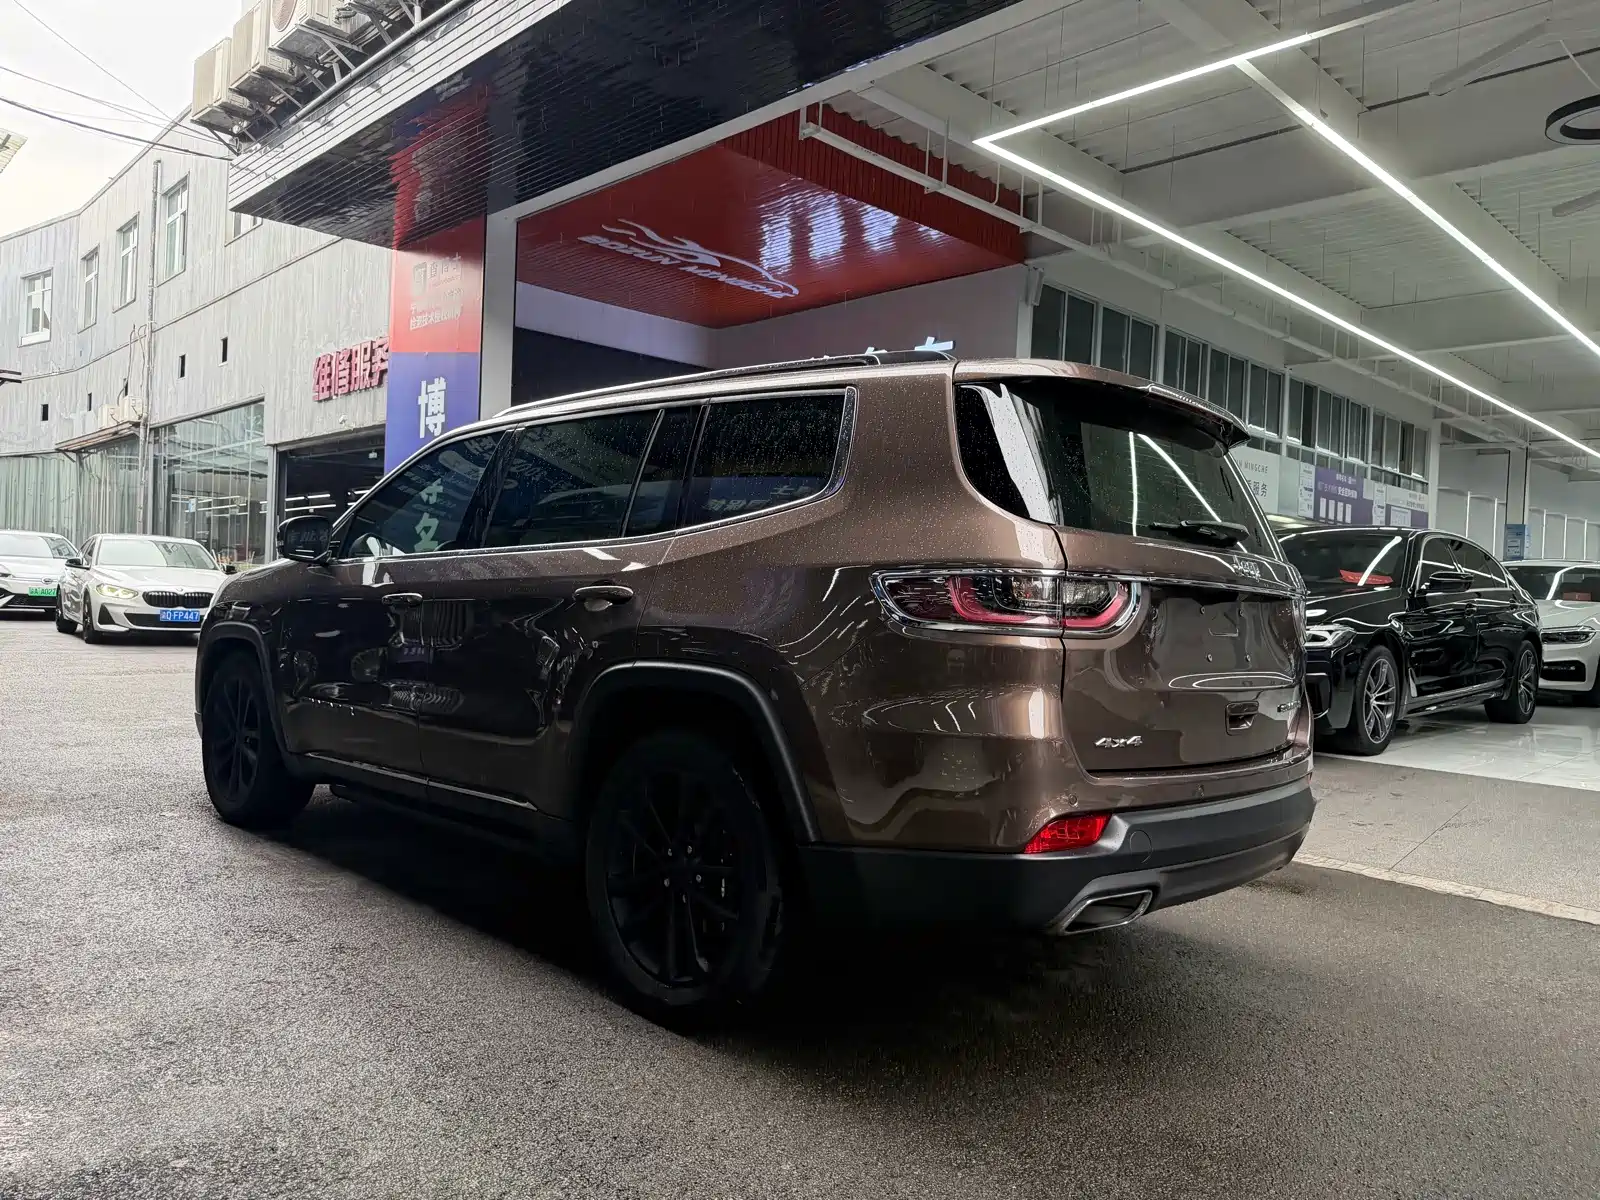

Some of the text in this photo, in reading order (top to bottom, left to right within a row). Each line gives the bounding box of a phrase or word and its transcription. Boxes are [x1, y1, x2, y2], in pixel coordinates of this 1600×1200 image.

[577, 234, 681, 265] BOZUN
[312, 337, 390, 402] 维修服务
